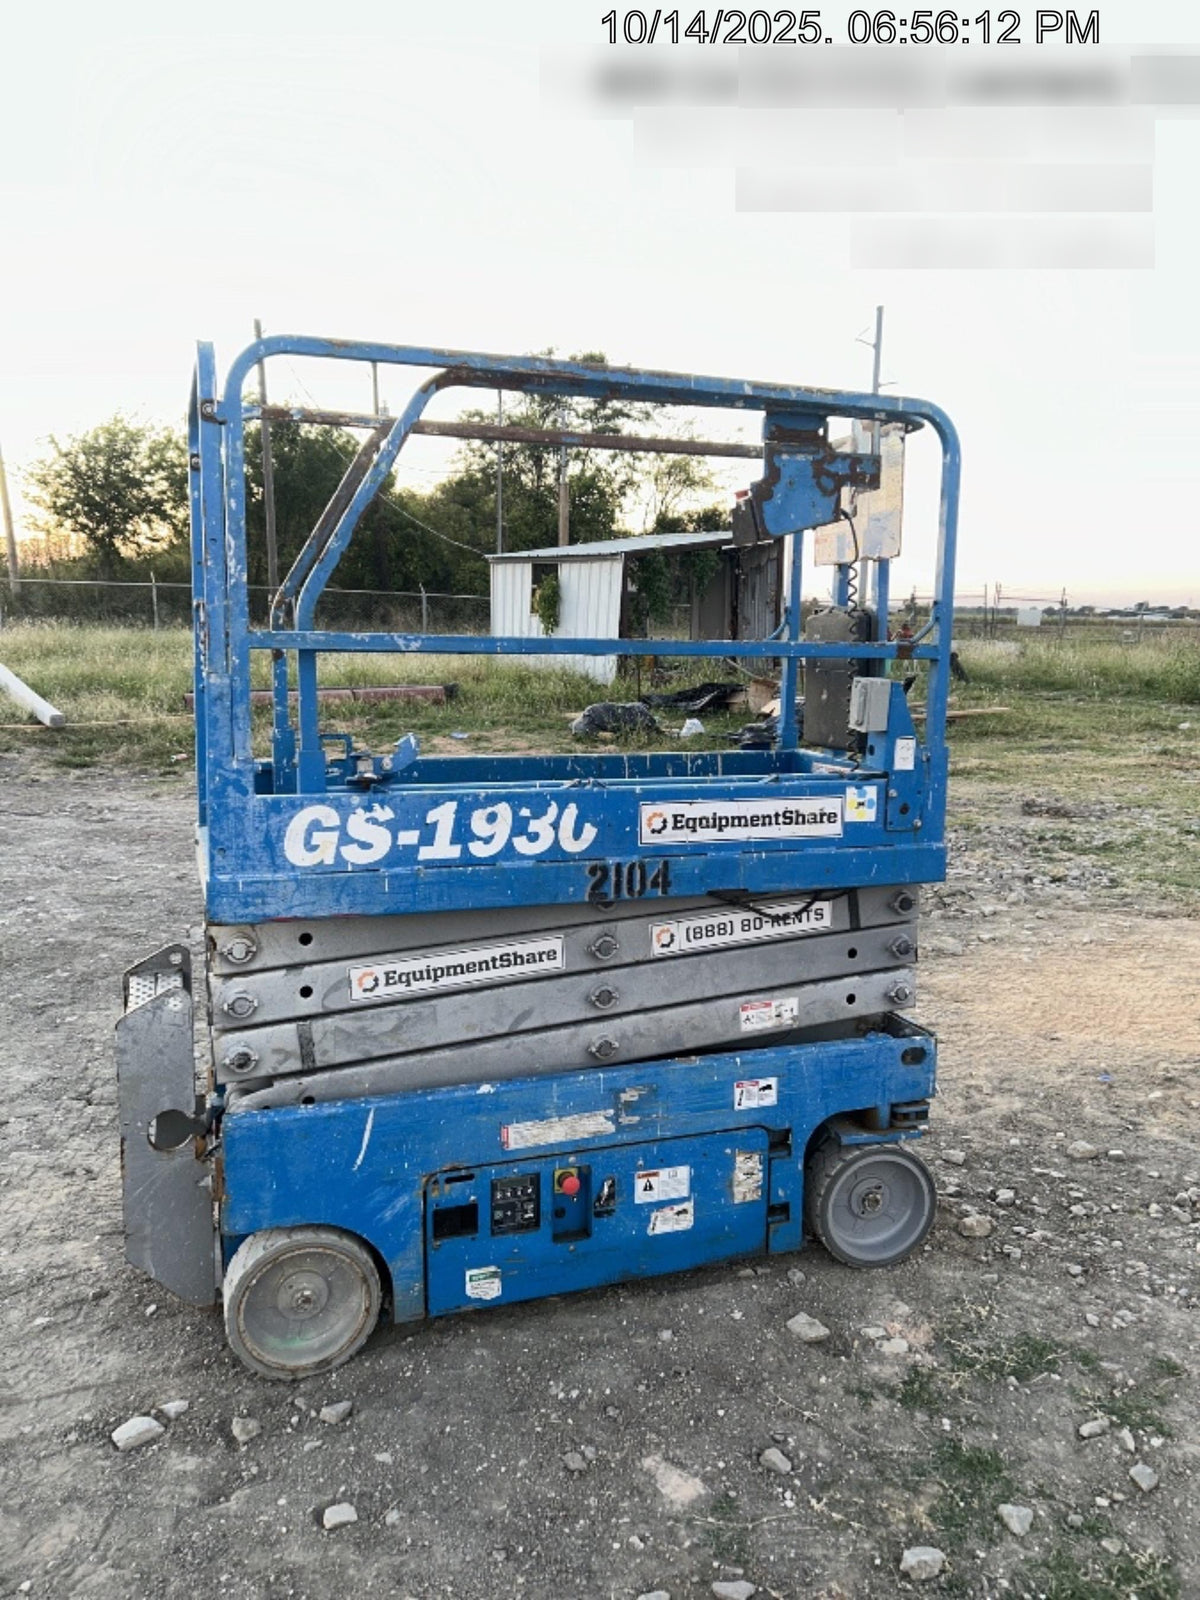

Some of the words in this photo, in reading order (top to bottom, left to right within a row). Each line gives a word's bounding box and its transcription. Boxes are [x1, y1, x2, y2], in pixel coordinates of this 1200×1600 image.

[671, 810, 838, 833] EquipmentShare
[587, 860, 671, 902] 2104
[685, 920, 734, 942] (888)
[384, 948, 557, 987] EquipmentShare
